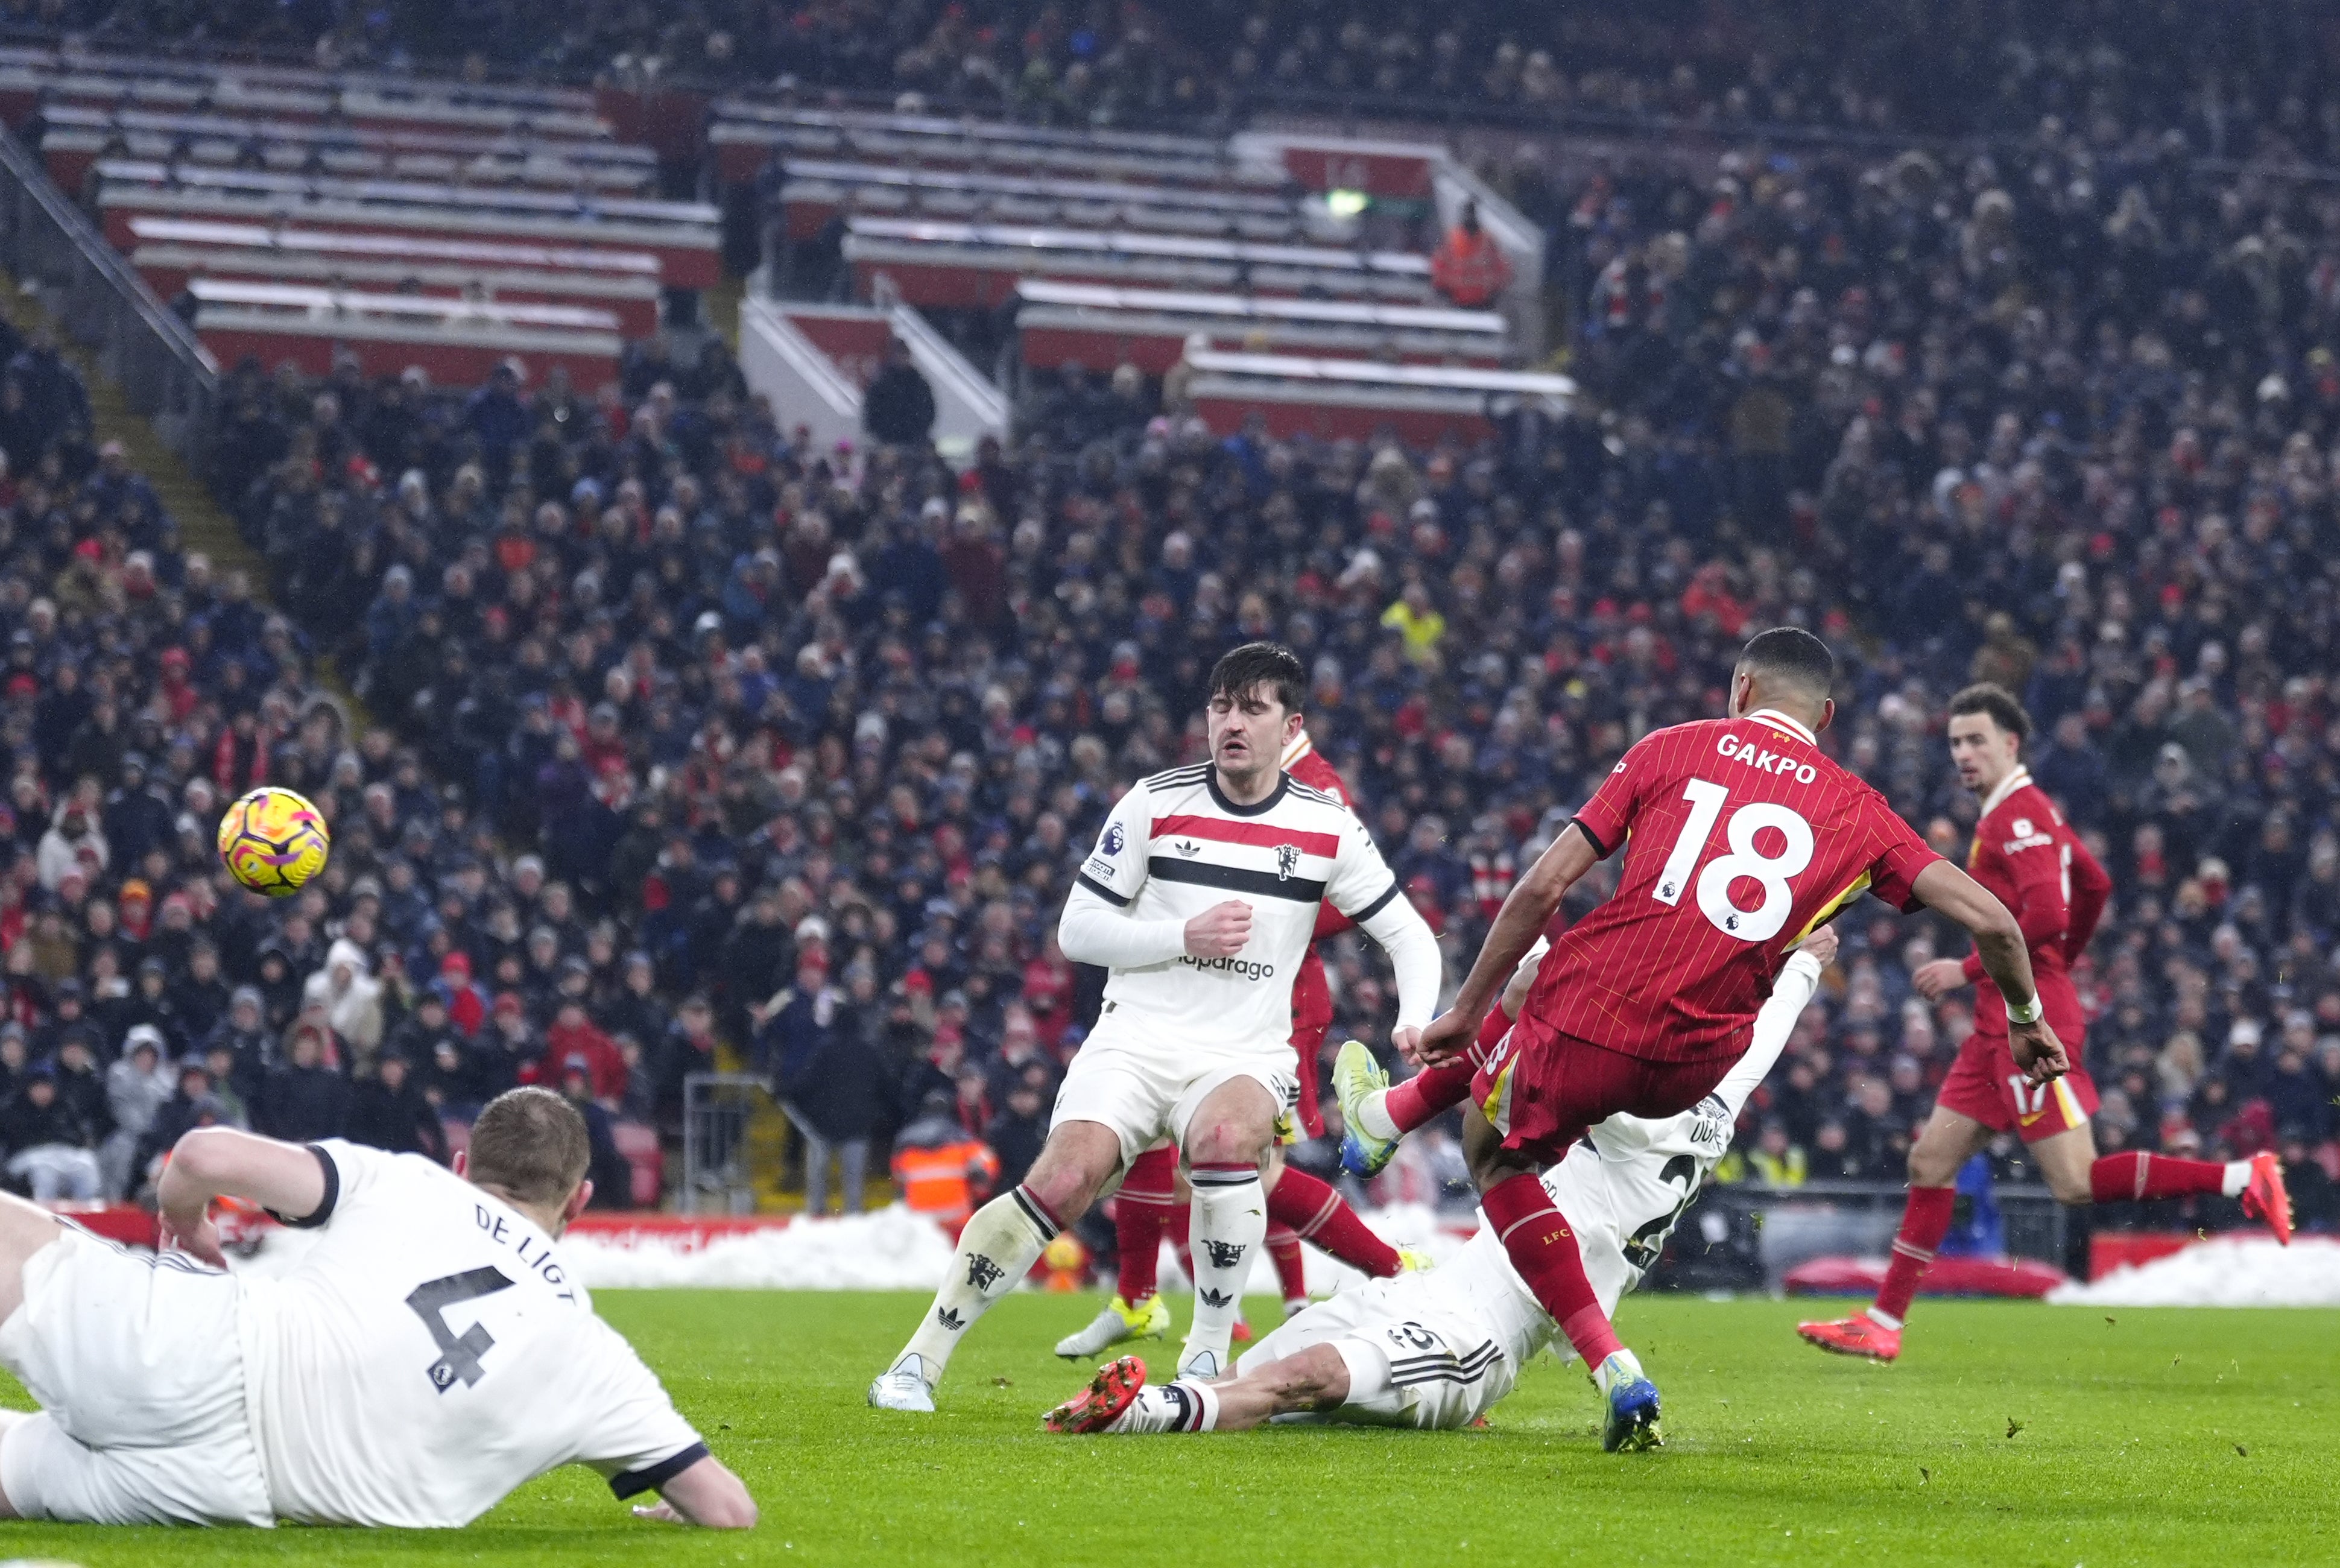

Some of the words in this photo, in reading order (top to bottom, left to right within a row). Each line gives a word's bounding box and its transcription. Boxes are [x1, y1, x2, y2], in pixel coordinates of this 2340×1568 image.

[1716, 733, 1817, 785] GAKPO
[1651, 777, 1815, 942] 18
[2007, 1073, 2047, 1115] 17
[475, 1204, 509, 1245] DE
[1542, 1228, 1570, 1246] LFC
[404, 1265, 517, 1395] 4
